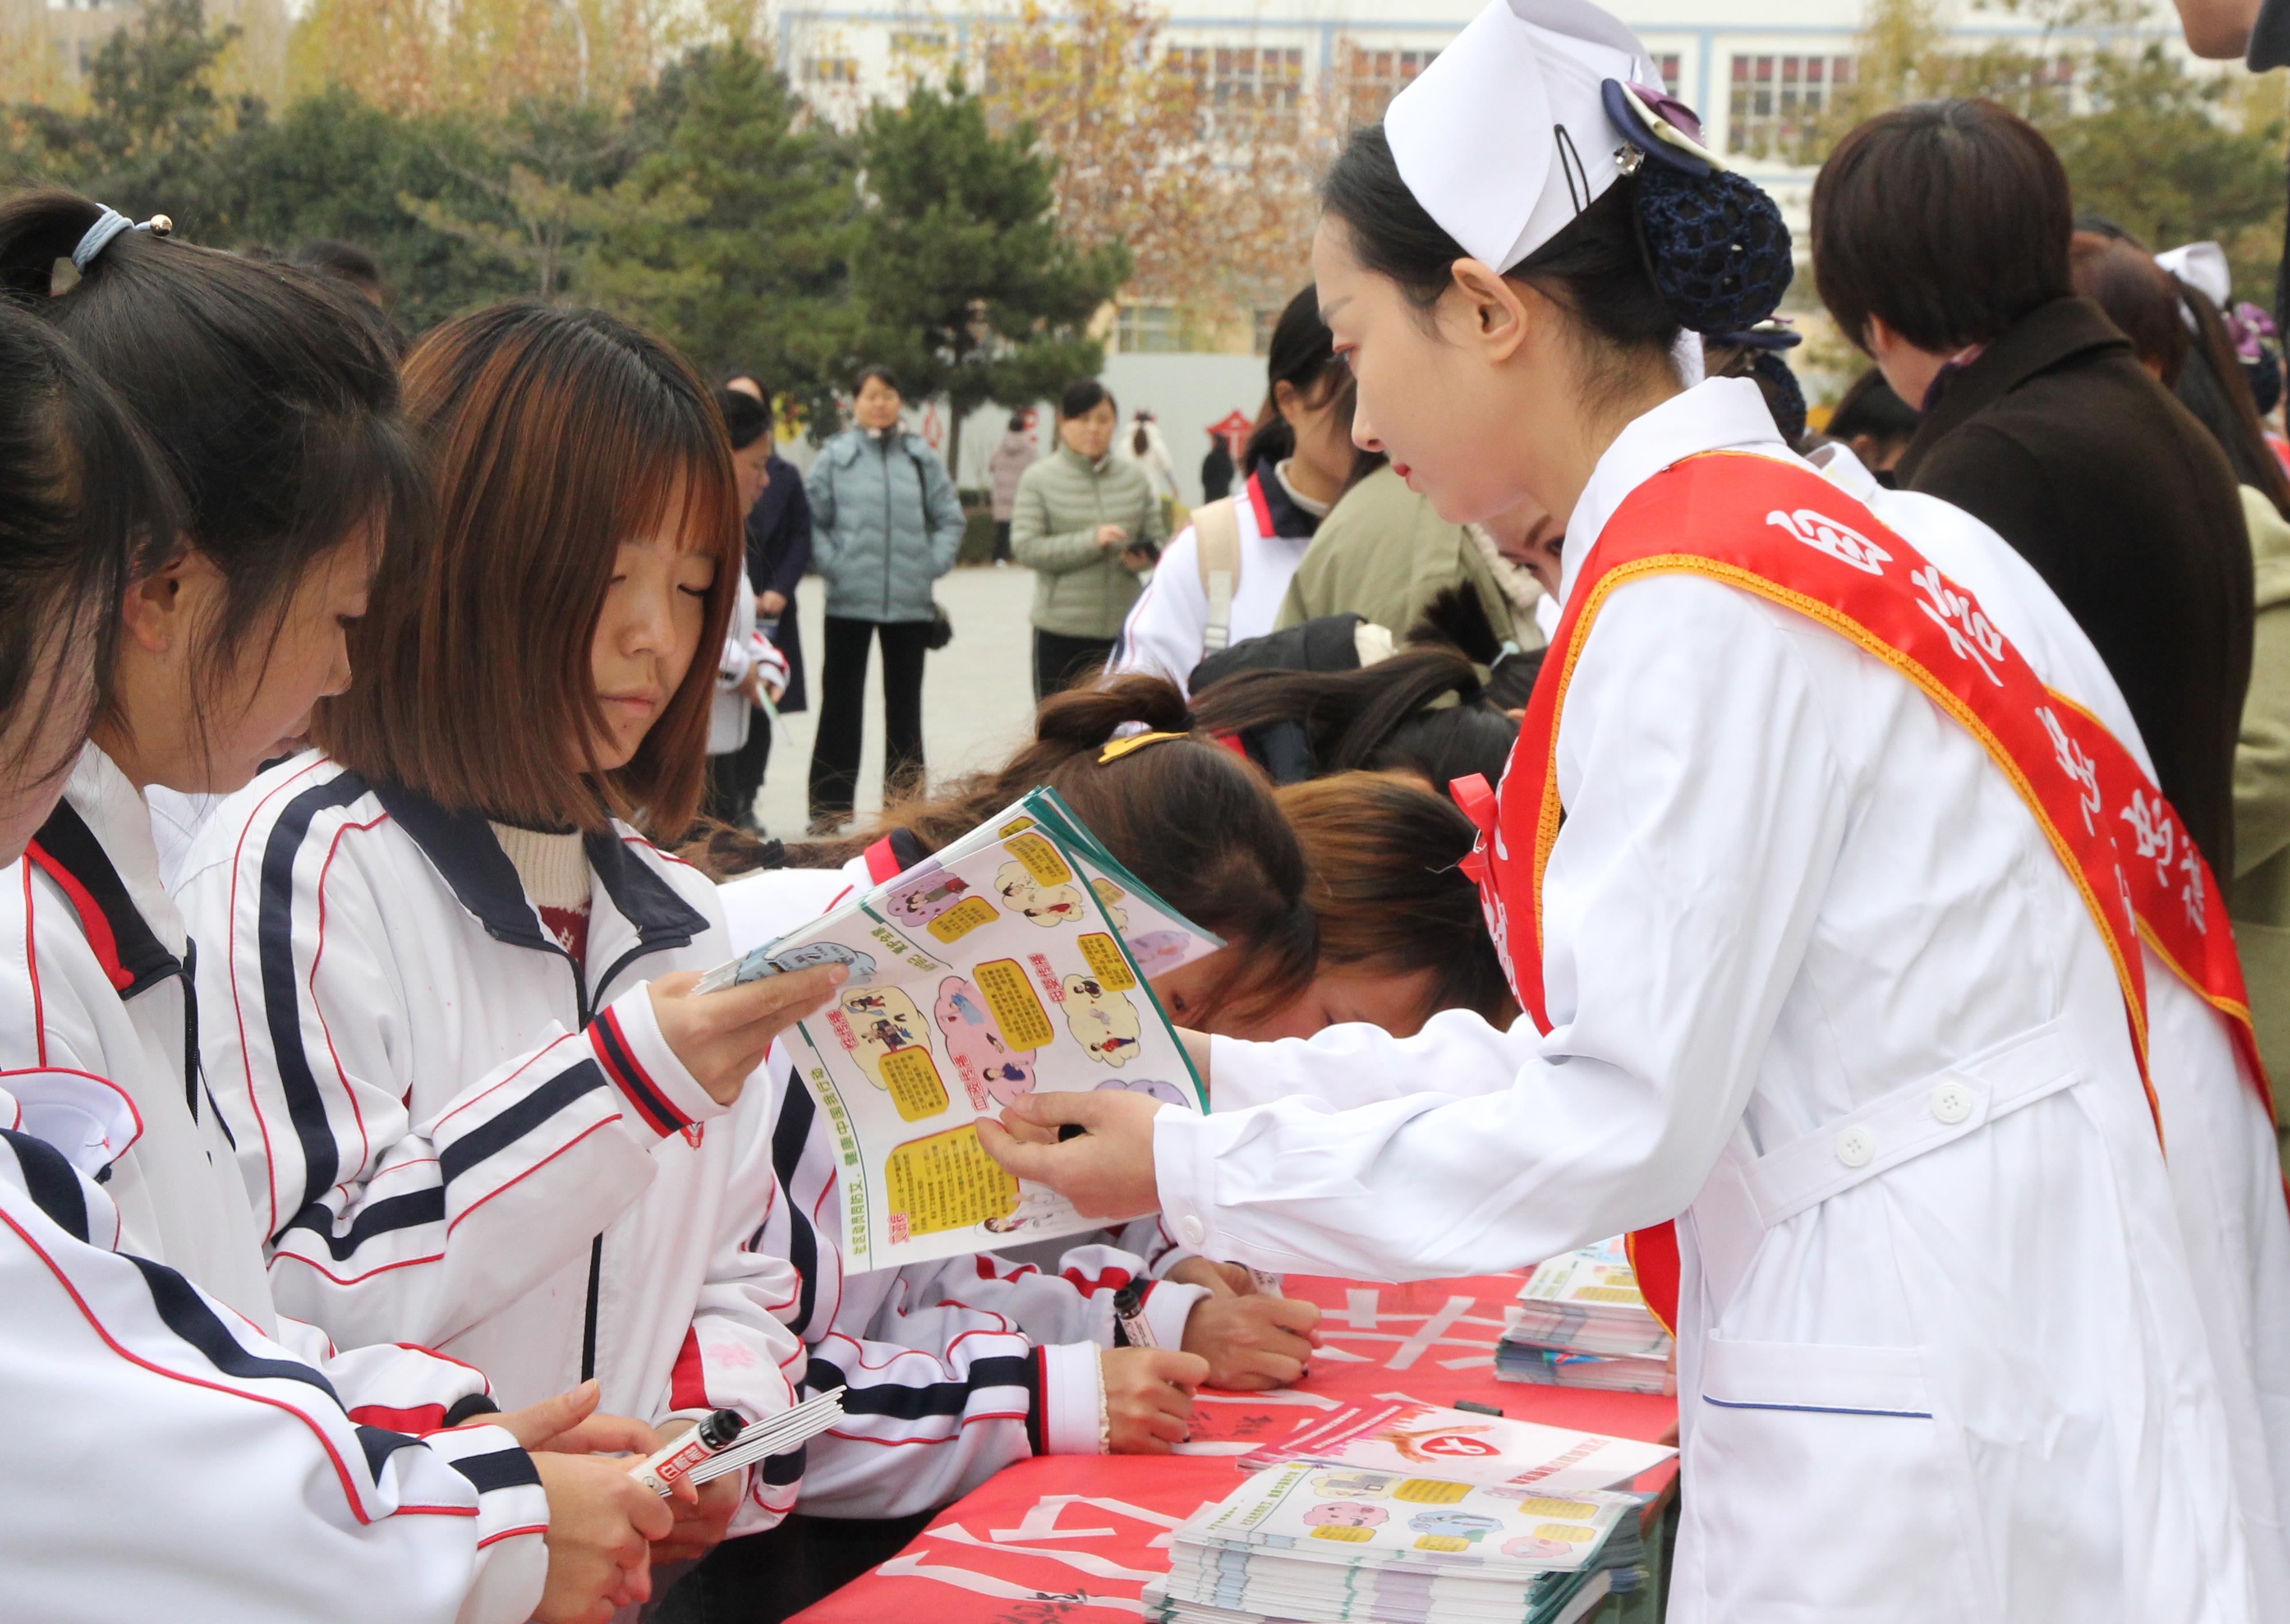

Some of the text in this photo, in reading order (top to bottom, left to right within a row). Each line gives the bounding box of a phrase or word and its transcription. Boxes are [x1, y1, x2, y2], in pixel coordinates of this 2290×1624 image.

[1027, 952, 1068, 1005] 母婴传播
[827, 1010, 860, 1052] 性传播
[952, 1053, 992, 1111] 血液传播
[889, 1211, 911, 1246] 艾滋病
